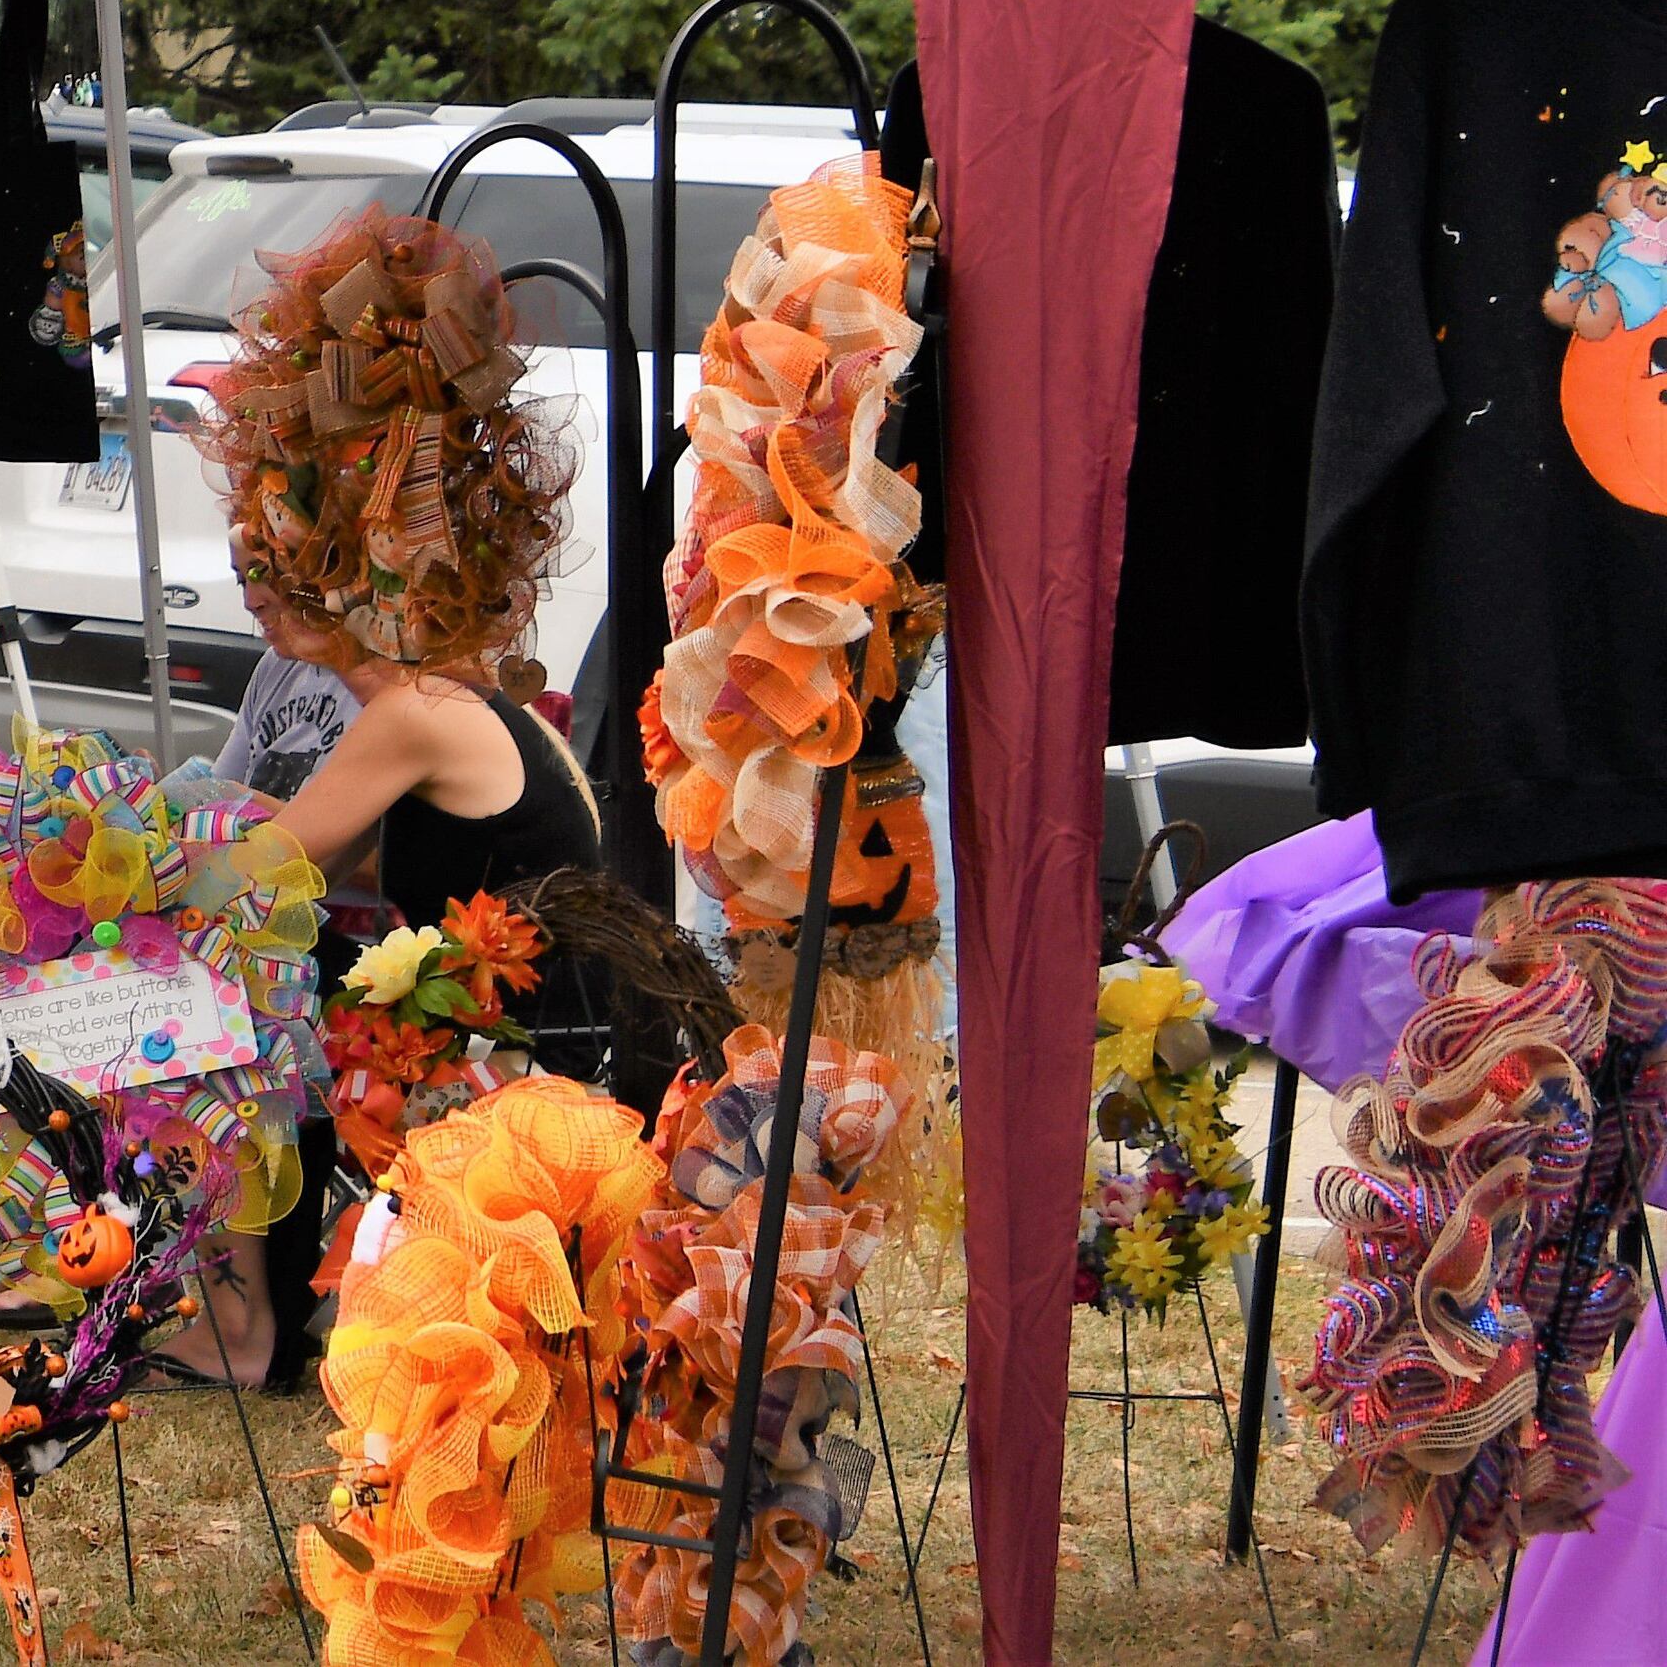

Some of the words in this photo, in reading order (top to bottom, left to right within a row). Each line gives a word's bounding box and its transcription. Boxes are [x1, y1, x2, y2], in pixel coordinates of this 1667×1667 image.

[46, 1015, 86, 1038] hold
[90, 997, 194, 1030] everything
[48, 996, 82, 1016] are
[84, 989, 114, 1008] like
